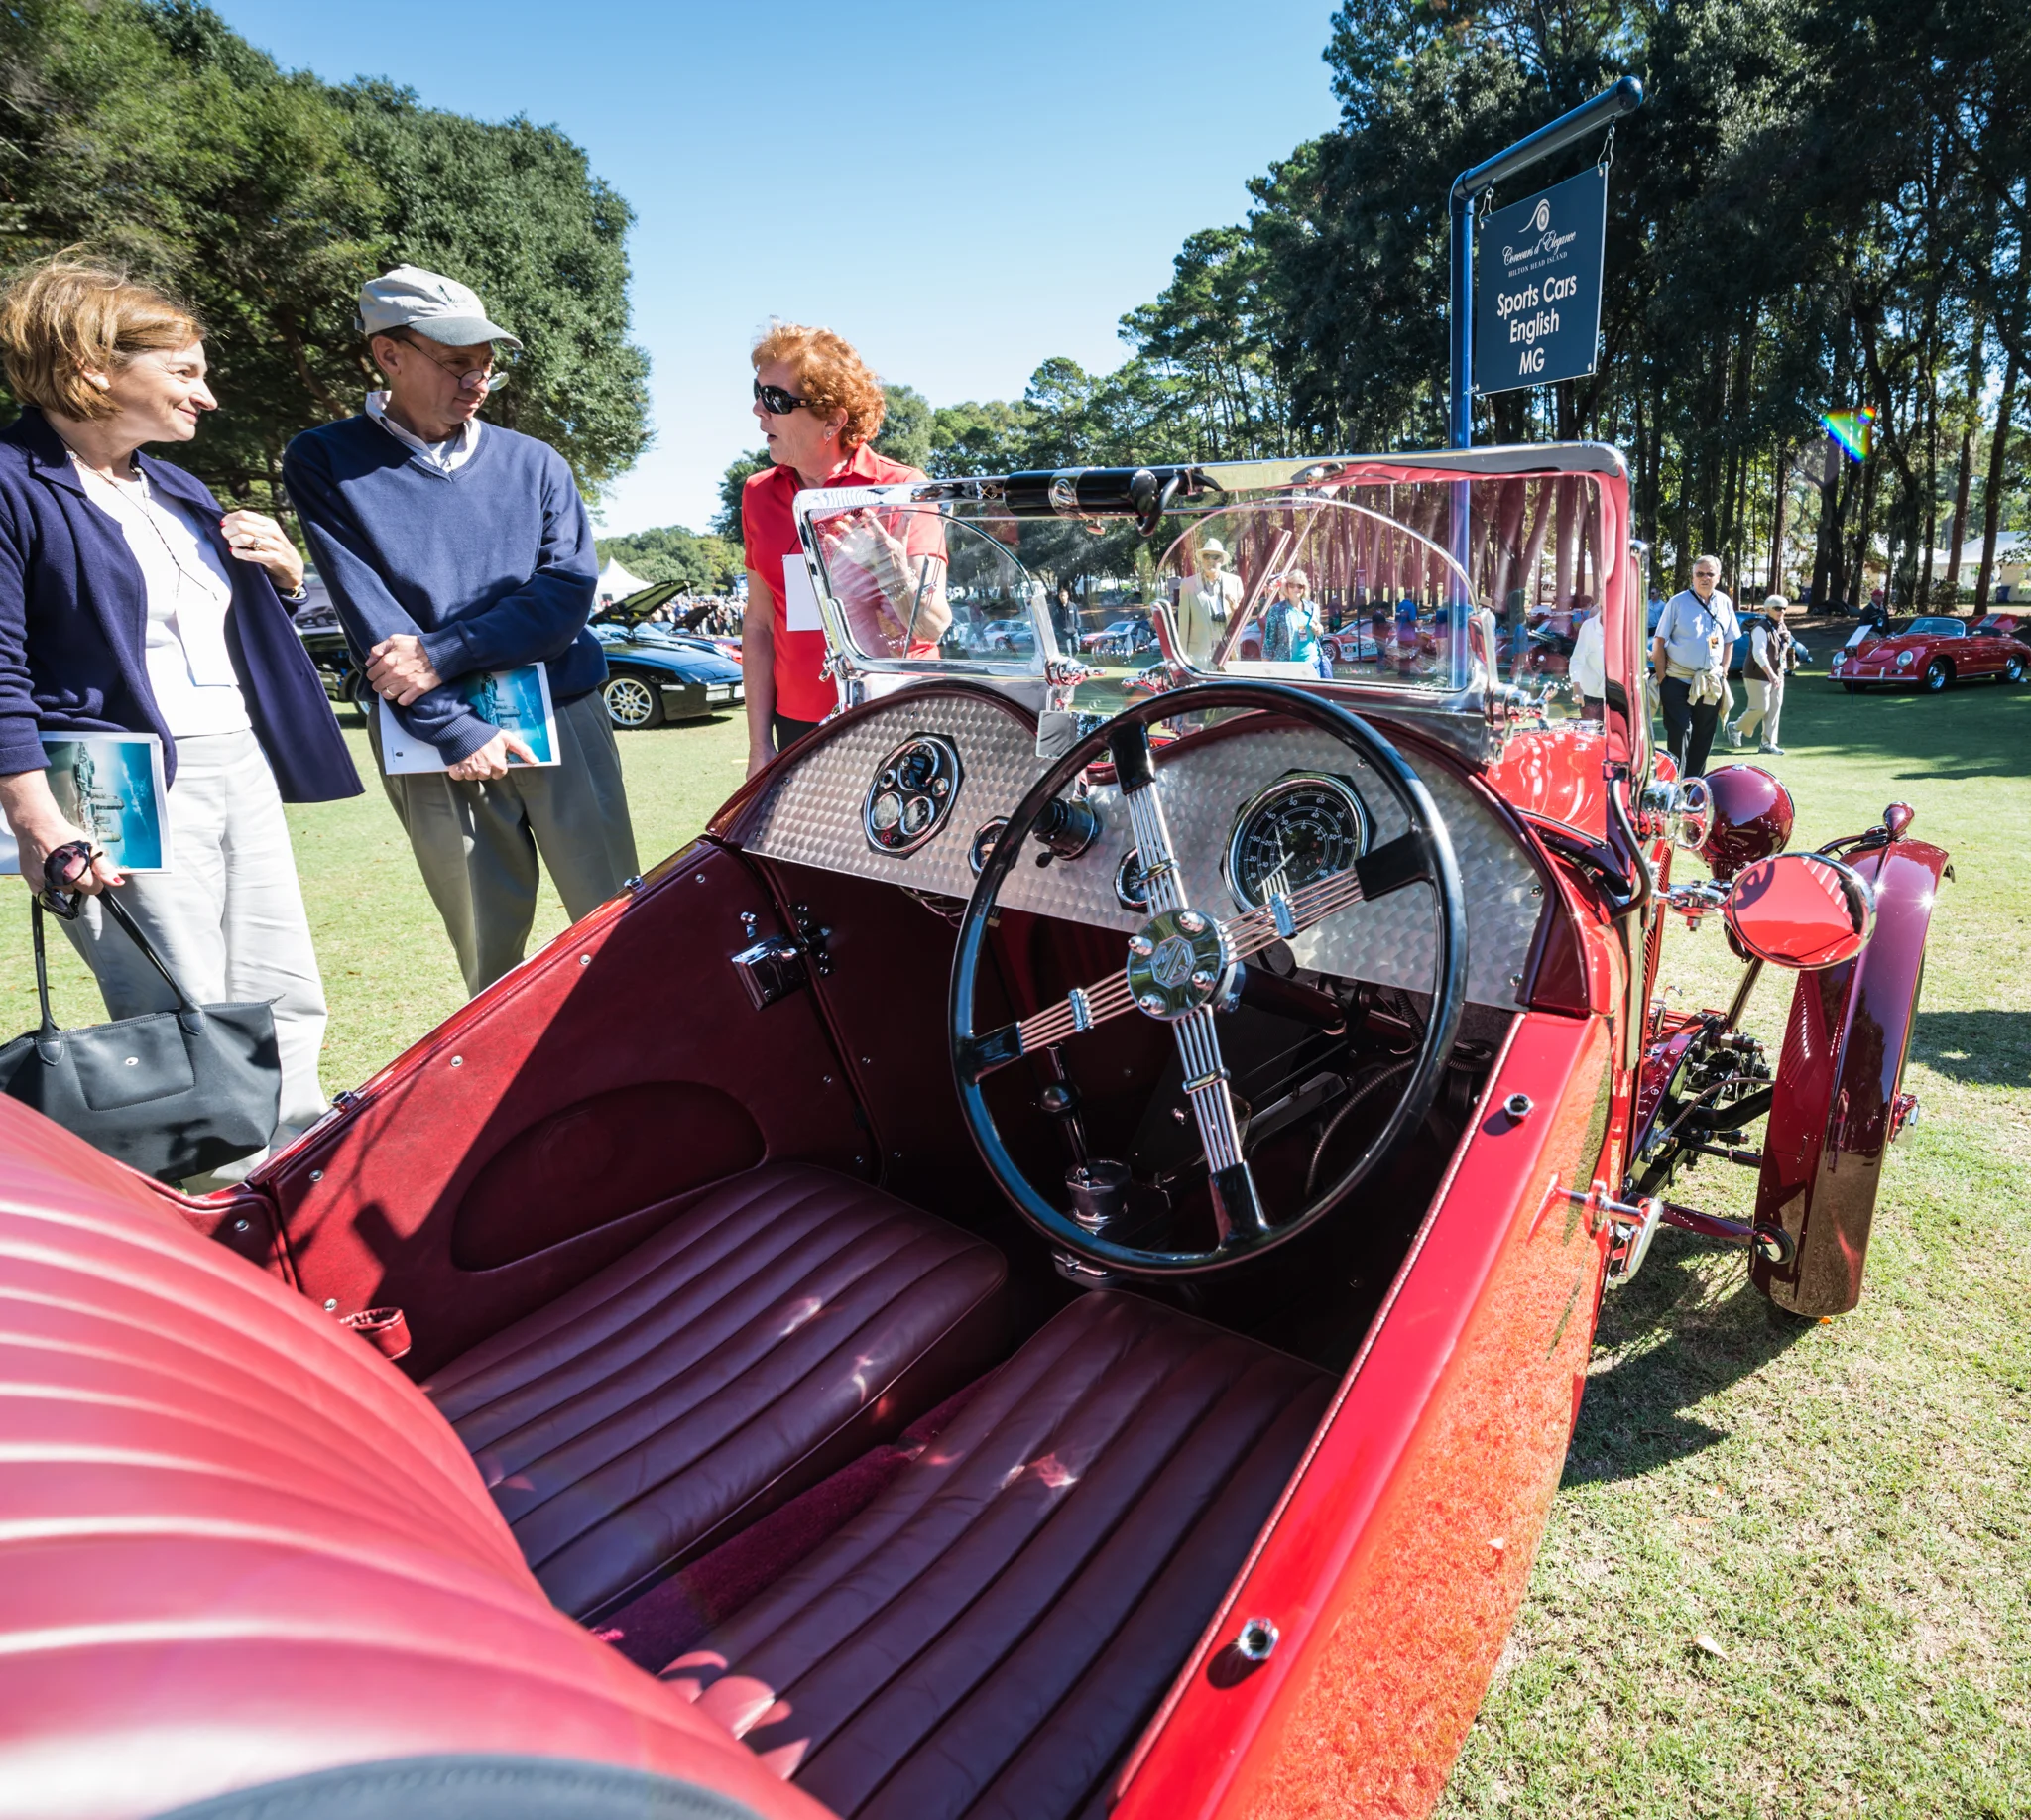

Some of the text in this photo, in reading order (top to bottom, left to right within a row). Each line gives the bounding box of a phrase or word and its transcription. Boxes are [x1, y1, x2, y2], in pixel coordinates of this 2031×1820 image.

[1502, 245, 1533, 266] Concours
[1508, 251, 1568, 278] HILTON HEAD ISLAND
[1496, 275, 1577, 320] Sports Cars
[1509, 307, 1560, 345] English
[1518, 347, 1545, 375] MG
[1153, 940, 1193, 983] MG
